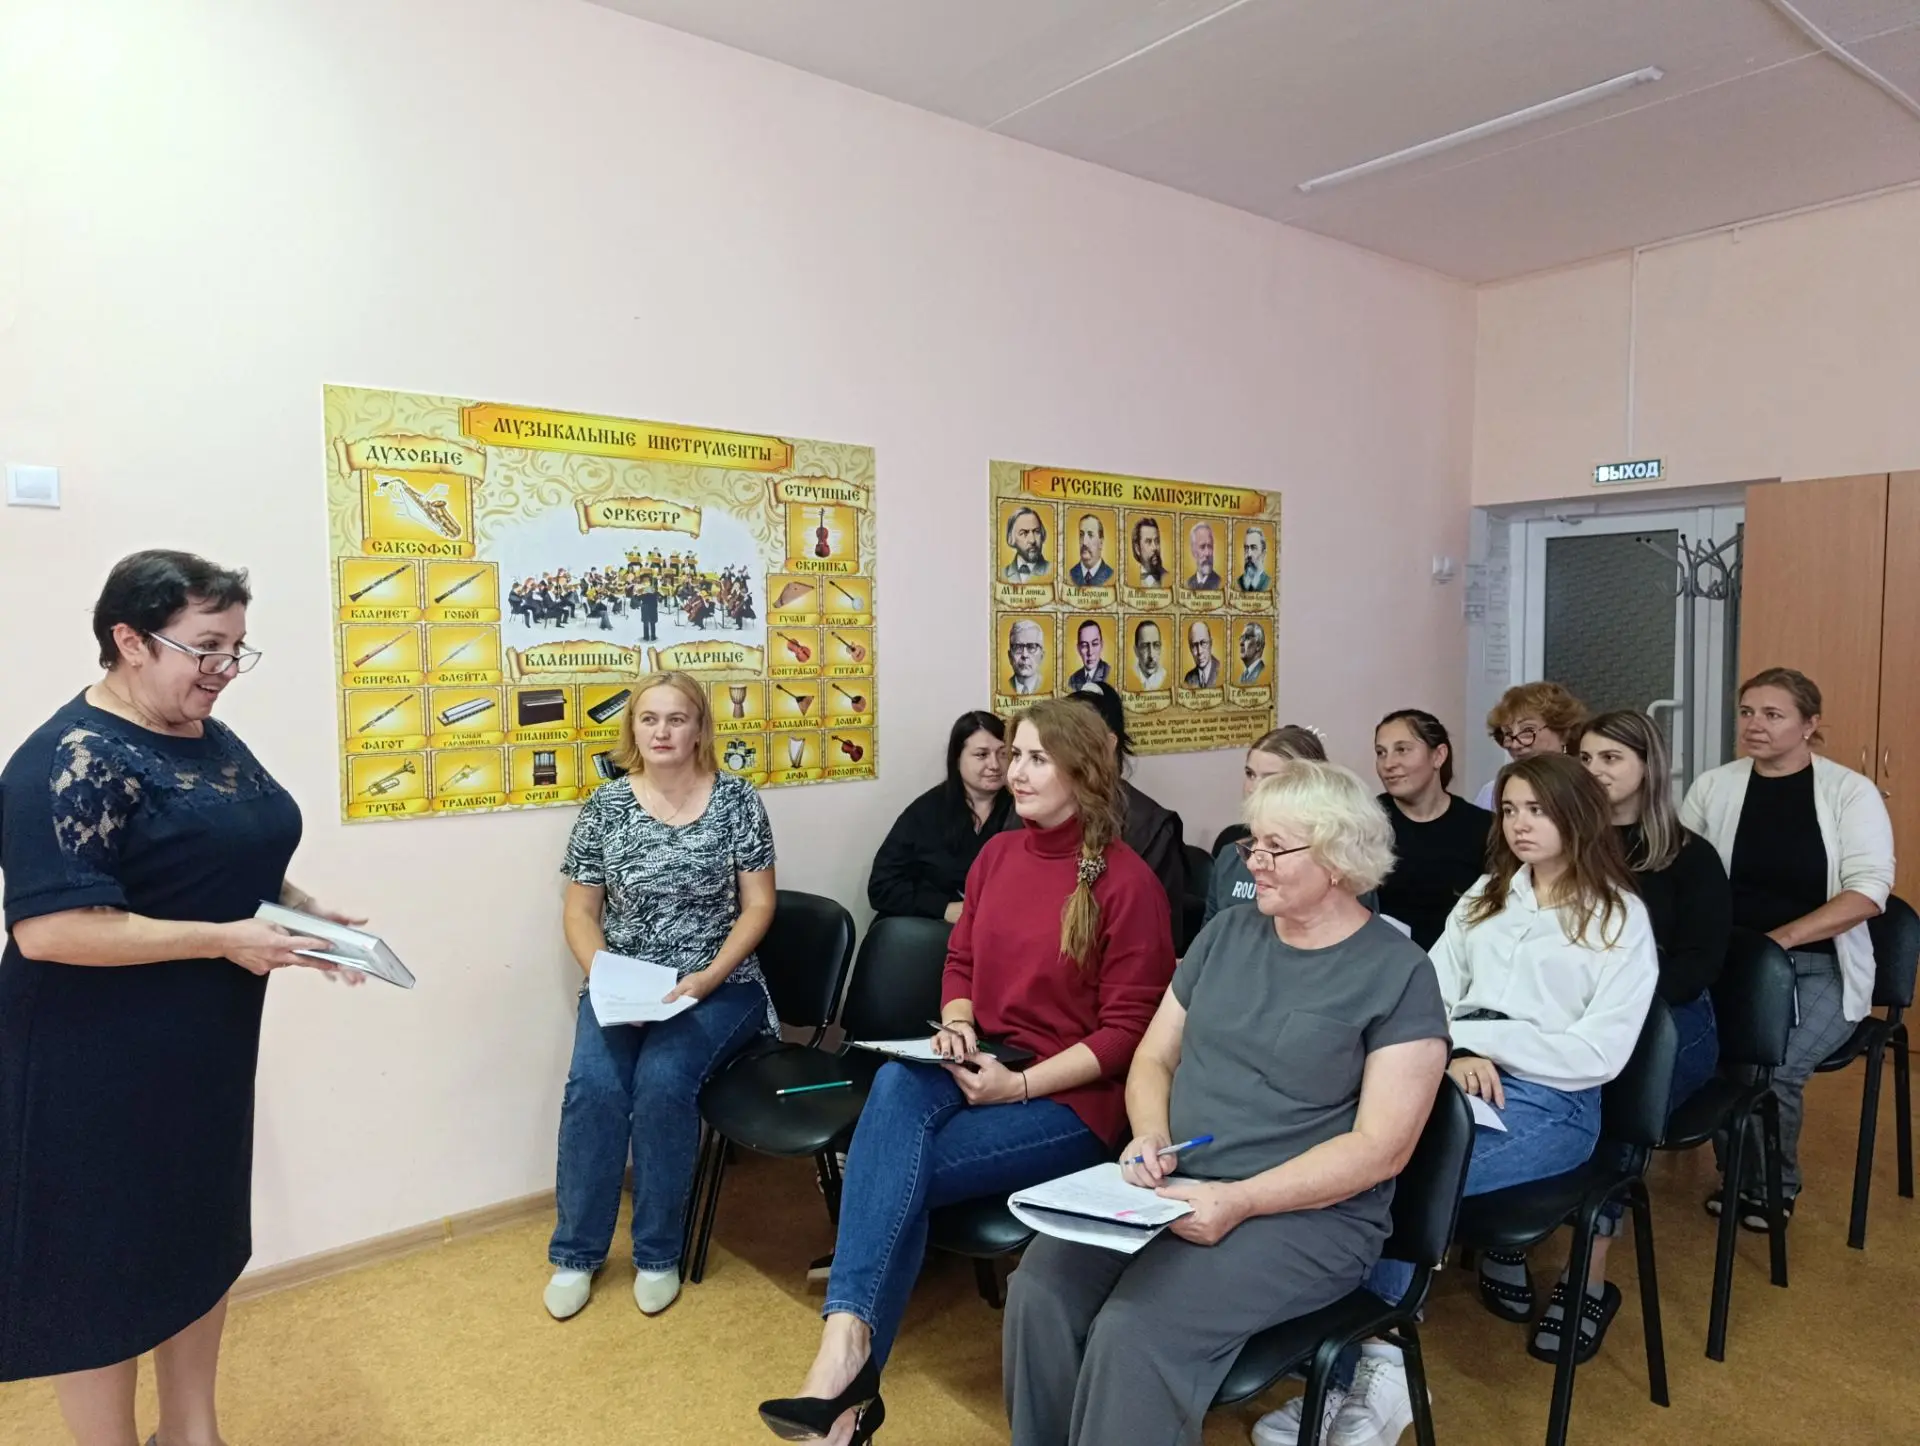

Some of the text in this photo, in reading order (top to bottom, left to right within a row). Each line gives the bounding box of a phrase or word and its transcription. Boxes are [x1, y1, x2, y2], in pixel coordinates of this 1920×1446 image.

[494, 417, 771, 461] МУЗЫКАЛЬНЫЕ ИНСТРУМЕНТЫ
[366, 445, 463, 466] ДУХОВЫЕ
[1598, 462, 1658, 481] ВЫХОД
[785, 484, 860, 502] СТРУННЫЕ
[1051, 476, 1241, 509] РУССКИЕ КОМПОЗИТОРЫ
[602, 506, 681, 524] ОРКЕСТР
[371, 540, 462, 556] САКСОФОН
[795, 561, 848, 572] СКРИПКА
[351, 609, 410, 619] КЛАРНЕТ
[444, 608, 479, 619] ГОБОЙ
[779, 615, 806, 624] ГУСЛИ
[826, 617, 858, 626] БАНДЖО
[525, 652, 634, 667] КЛАВИШНЫЕ
[674, 651, 744, 667] УДАРНЫЕ
[771, 667, 818, 676] КОНТРАБАС
[834, 667, 865, 675] ГИТАРА
[353, 674, 410, 685] СВИРЕЛЬ
[438, 672, 488, 682] ФЛЕЙТА
[772, 718, 819, 728] БАЛАЛАЙКА
[835, 717, 862, 726] ДОМРА
[515, 731, 568, 742] ПИАНИНО
[584, 729, 620, 738] СИНТЕЗ
[361, 739, 404, 750] ФАГОТ
[785, 771, 808, 780] АРФА
[525, 791, 559, 801] ОРГАН
[440, 796, 496, 808] ТРАМБОН
[365, 802, 406, 815] ТРУБА
[1231, 880, 1257, 899] ROU
